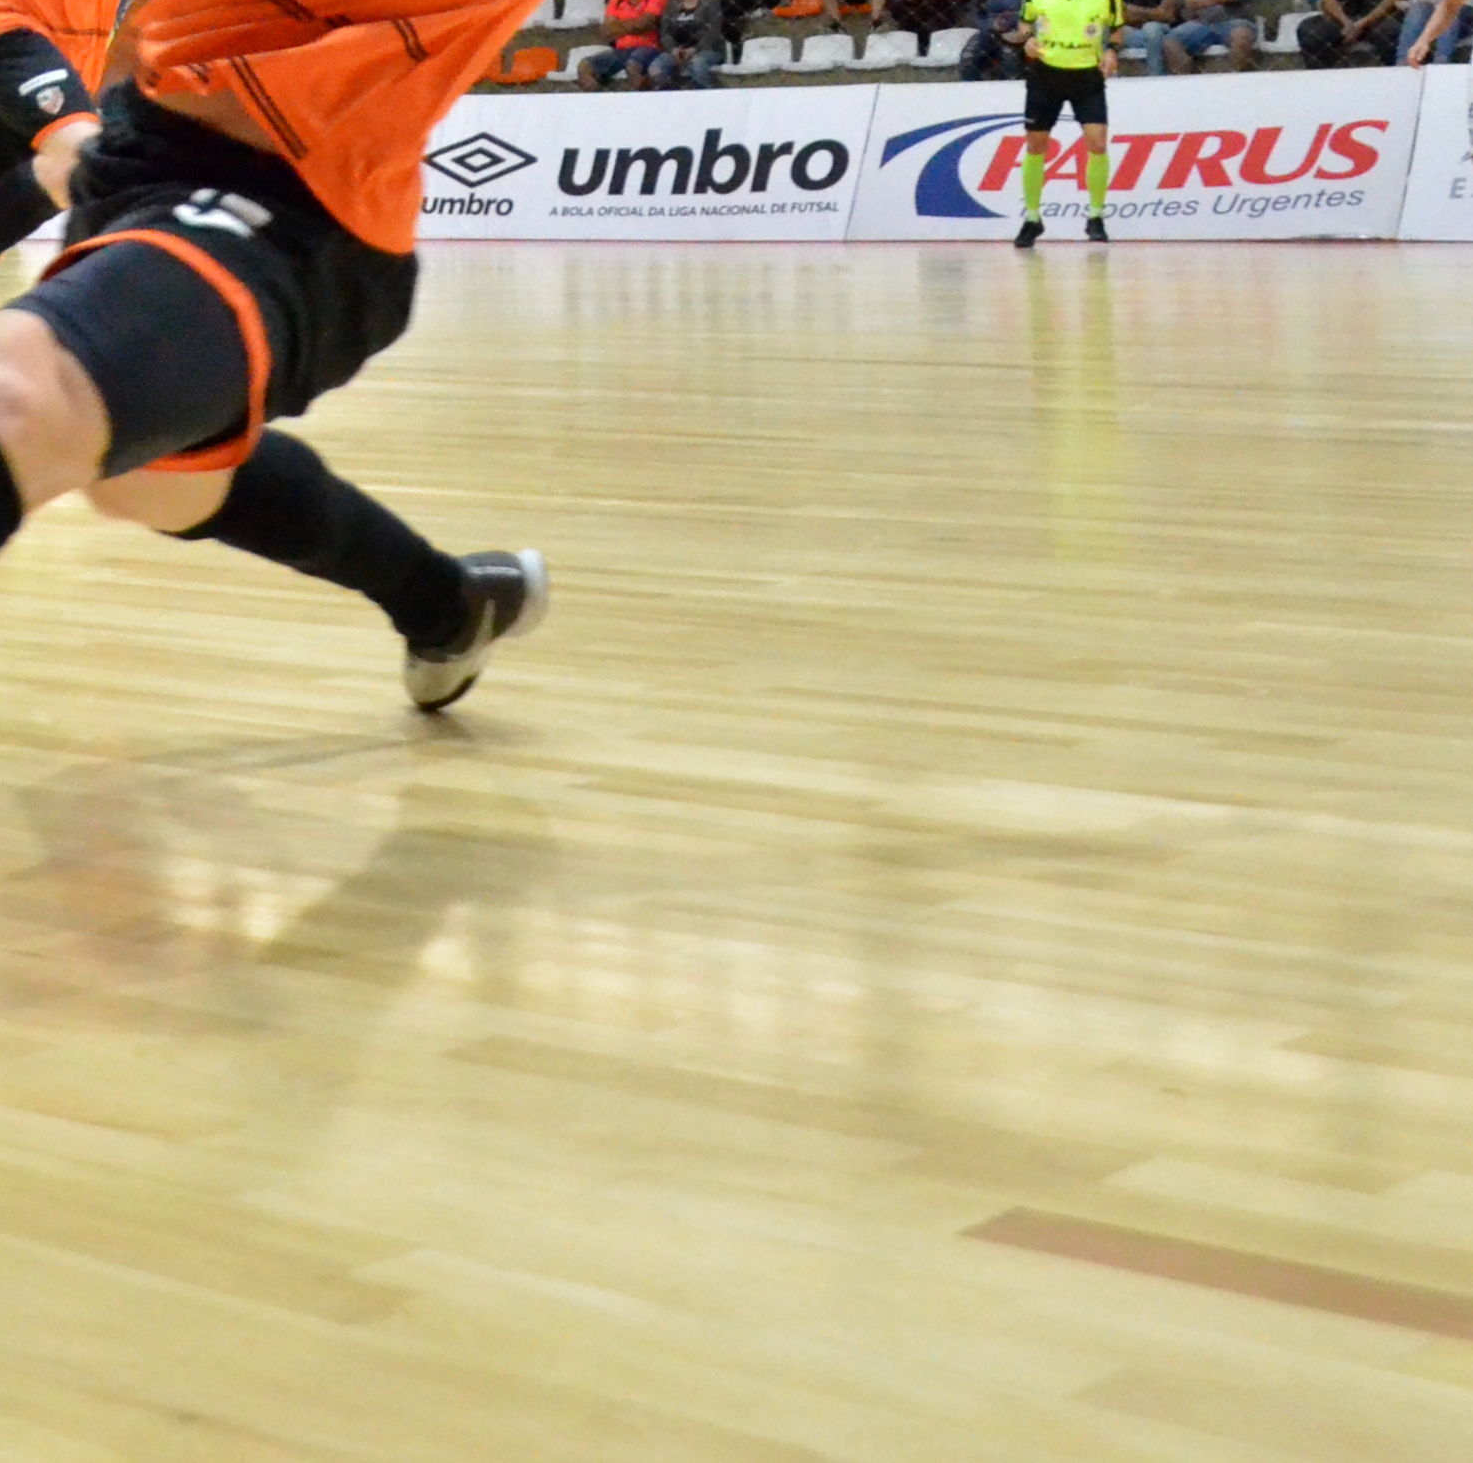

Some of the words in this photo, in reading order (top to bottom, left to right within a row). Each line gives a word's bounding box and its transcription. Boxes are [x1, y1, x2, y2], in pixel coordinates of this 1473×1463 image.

[558, 127, 851, 197] umbro
[977, 119, 1390, 192] PATRUS
[421, 192, 515, 217] umbro
[562, 205, 595, 217] BOLA
[597, 205, 644, 217] OFICIAL
[648, 205, 666, 217] DA
[669, 205, 698, 217] LIGA
[701, 204, 768, 217] NACIONAL
[770, 202, 788, 214] DE
[790, 200, 841, 214] FUTSAL
[1212, 187, 1365, 219] Urgentes
